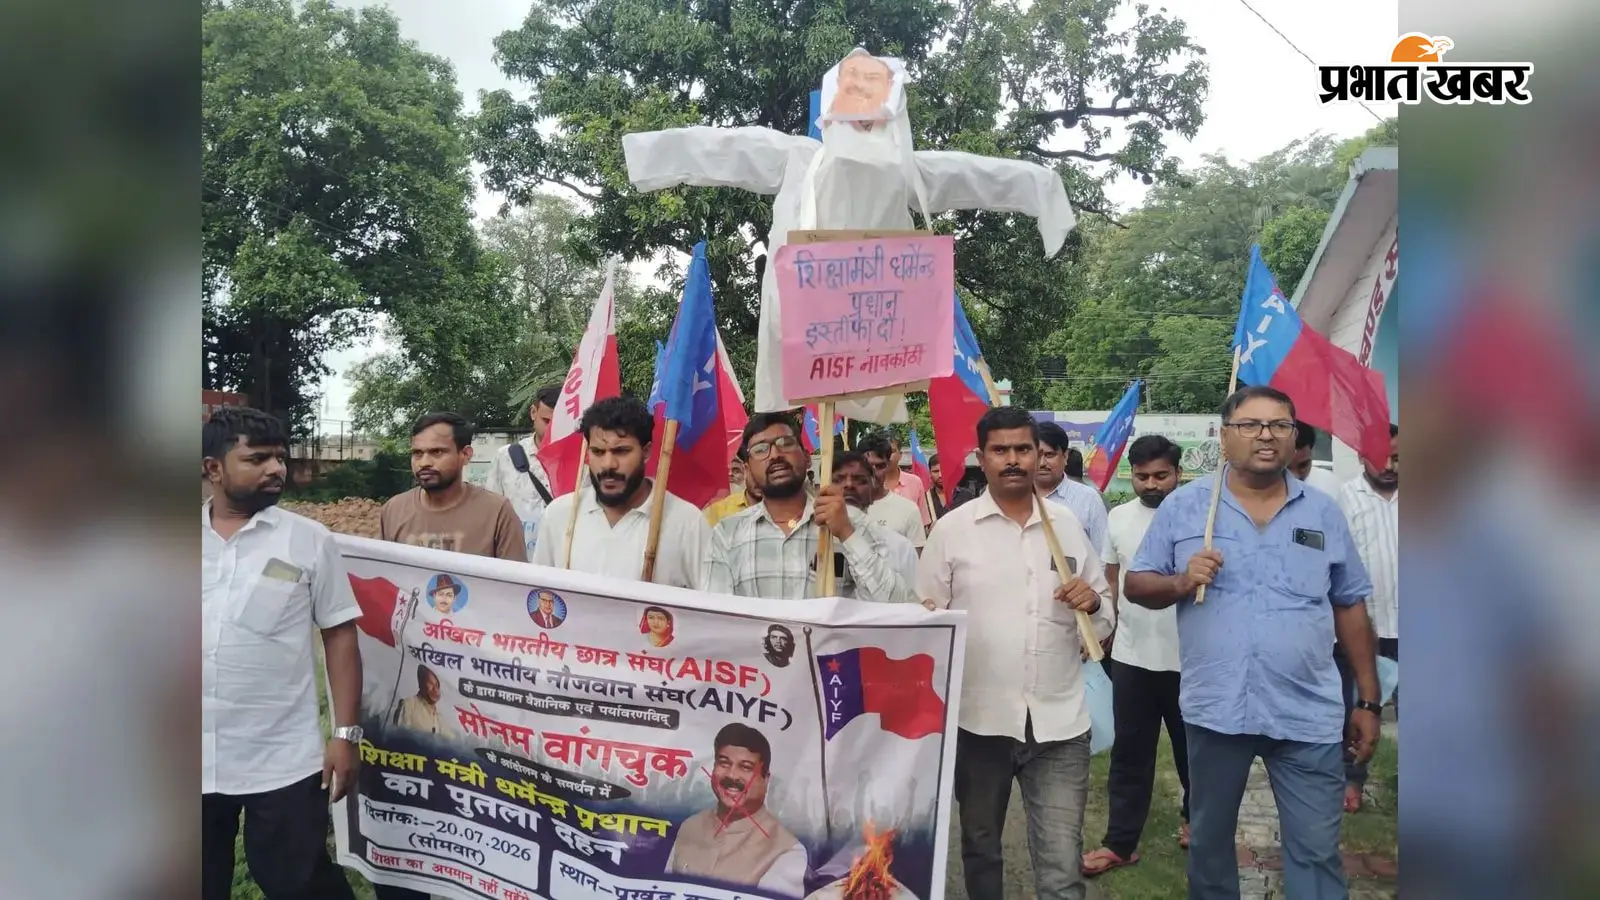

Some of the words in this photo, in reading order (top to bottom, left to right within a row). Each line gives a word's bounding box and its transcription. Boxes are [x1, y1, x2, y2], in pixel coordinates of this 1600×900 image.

[810, 356, 855, 380] AISF
[422, 618, 486, 647] अखिल
[492, 629, 569, 660] भारतीय
[574, 644, 620, 667] छात्र
[407, 642, 465, 670] अखिल
[470, 656, 540, 685] भारतीय
[547, 664, 636, 699] नौजवान
[463, 682, 475, 694] के
[476, 685, 495, 699] द्वारा
[497, 689, 523, 704] महान
[575, 701, 593, 714] एवं
[829, 674, 843, 723] AIYF
[454, 703, 535, 756] सोनम
[541, 725, 694, 788] वांगचुक
[359, 739, 427, 773] शिक्षा
[435, 757, 488, 788] मंत्री
[573, 804, 672, 838] प्रधान
[485, 751, 497, 764] के
[540, 772, 552, 784] के
[555, 777, 595, 797] समर्थन
[599, 784, 613, 799] में
[380, 771, 434, 800] का
[445, 783, 542, 832] पुतला
[551, 817, 629, 866] दहन
[371, 848, 400, 867] शिक्षा
[404, 857, 425, 870] का
[431, 863, 474, 885] अपमान
[478, 878, 500, 895] नहीं
[408, 832, 486, 866] (सोमवार)
